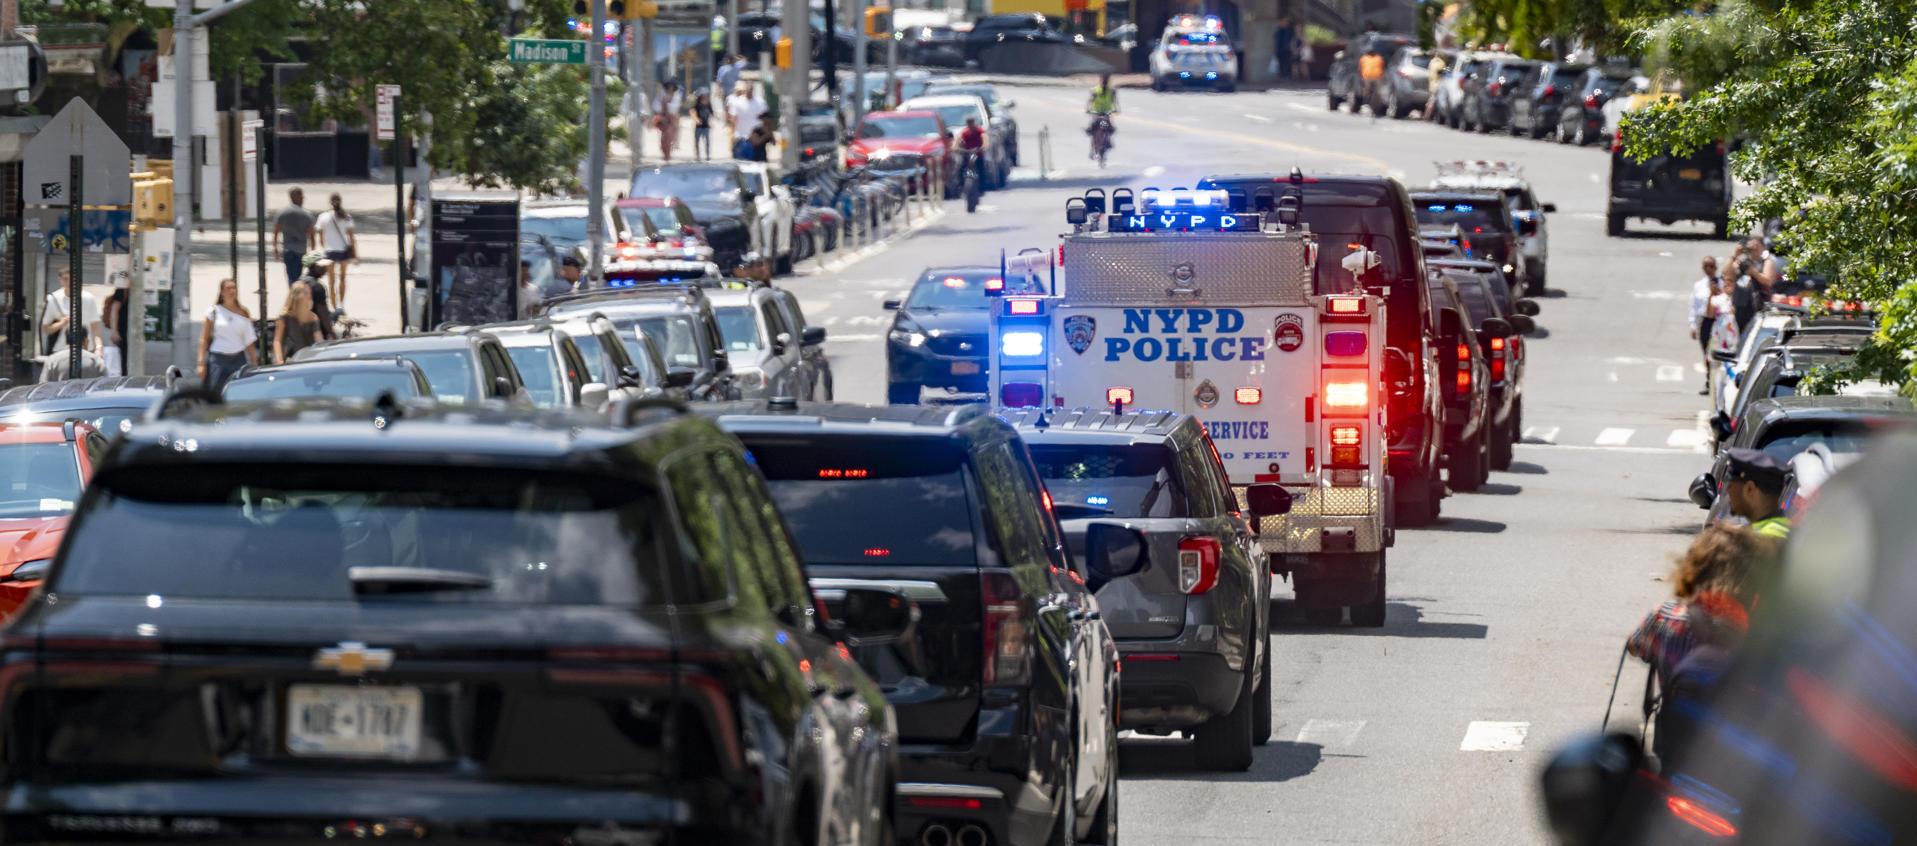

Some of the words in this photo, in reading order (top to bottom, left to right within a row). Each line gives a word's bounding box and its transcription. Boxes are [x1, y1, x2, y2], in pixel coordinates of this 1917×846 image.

[514, 42, 568, 60] Madison
[571, 43, 581, 53] St
[1123, 308, 1245, 333] NYPD
[1276, 314, 1302, 325] POLICE
[1104, 338, 1265, 362] POLICE
[1243, 452, 1290, 460] FEET
